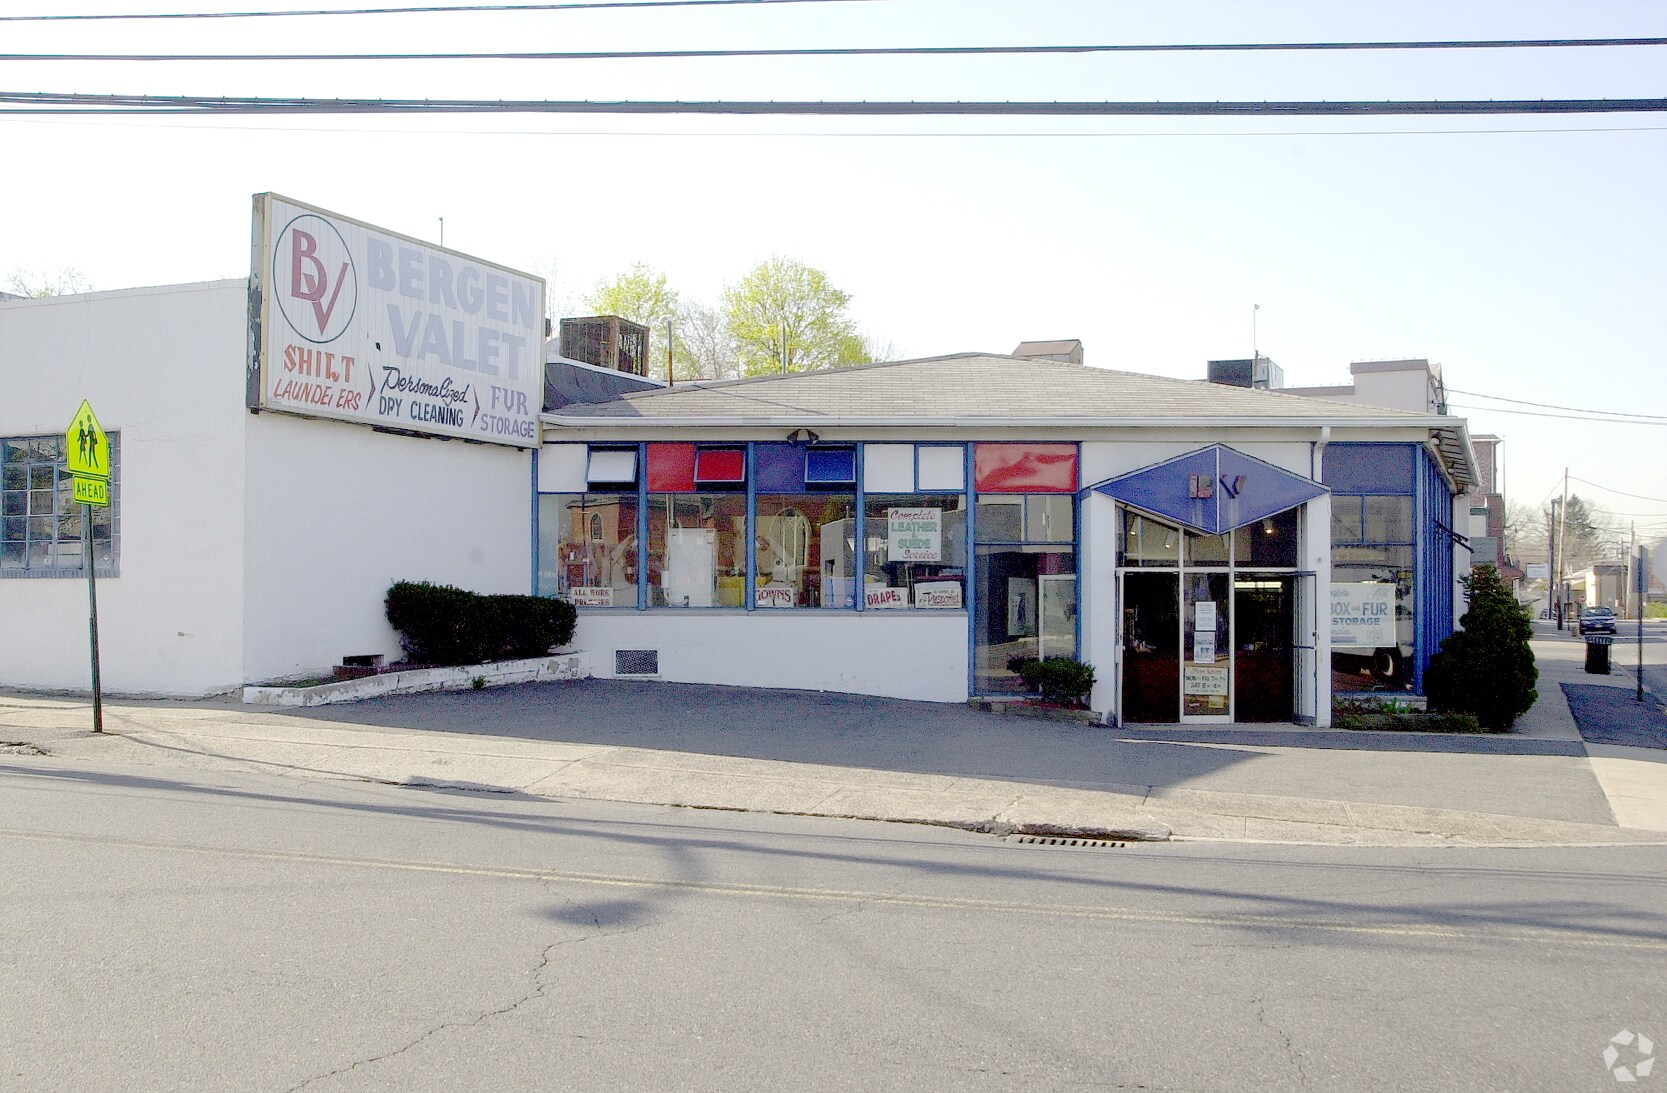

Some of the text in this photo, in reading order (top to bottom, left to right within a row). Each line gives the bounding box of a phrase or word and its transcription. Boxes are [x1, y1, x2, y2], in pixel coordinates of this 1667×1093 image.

[367, 236, 535, 330] BERGEN
[386, 303, 526, 381] VALET
[273, 378, 361, 411] LAUNDEERS
[380, 365, 470, 406] Personalized
[490, 385, 529, 416] FUR
[410, 400, 464, 427] CLEANING
[480, 413, 535, 438] STORAGE
[76, 482, 104, 499] AHEAD
[891, 510, 936, 521] Complete
[891, 521, 938, 532] LEATHER
[898, 538, 931, 549] SUEDE
[902, 549, 938, 560] Service
[1362, 601, 1388, 616] FUR
[1332, 617, 1381, 626] STORAGE
